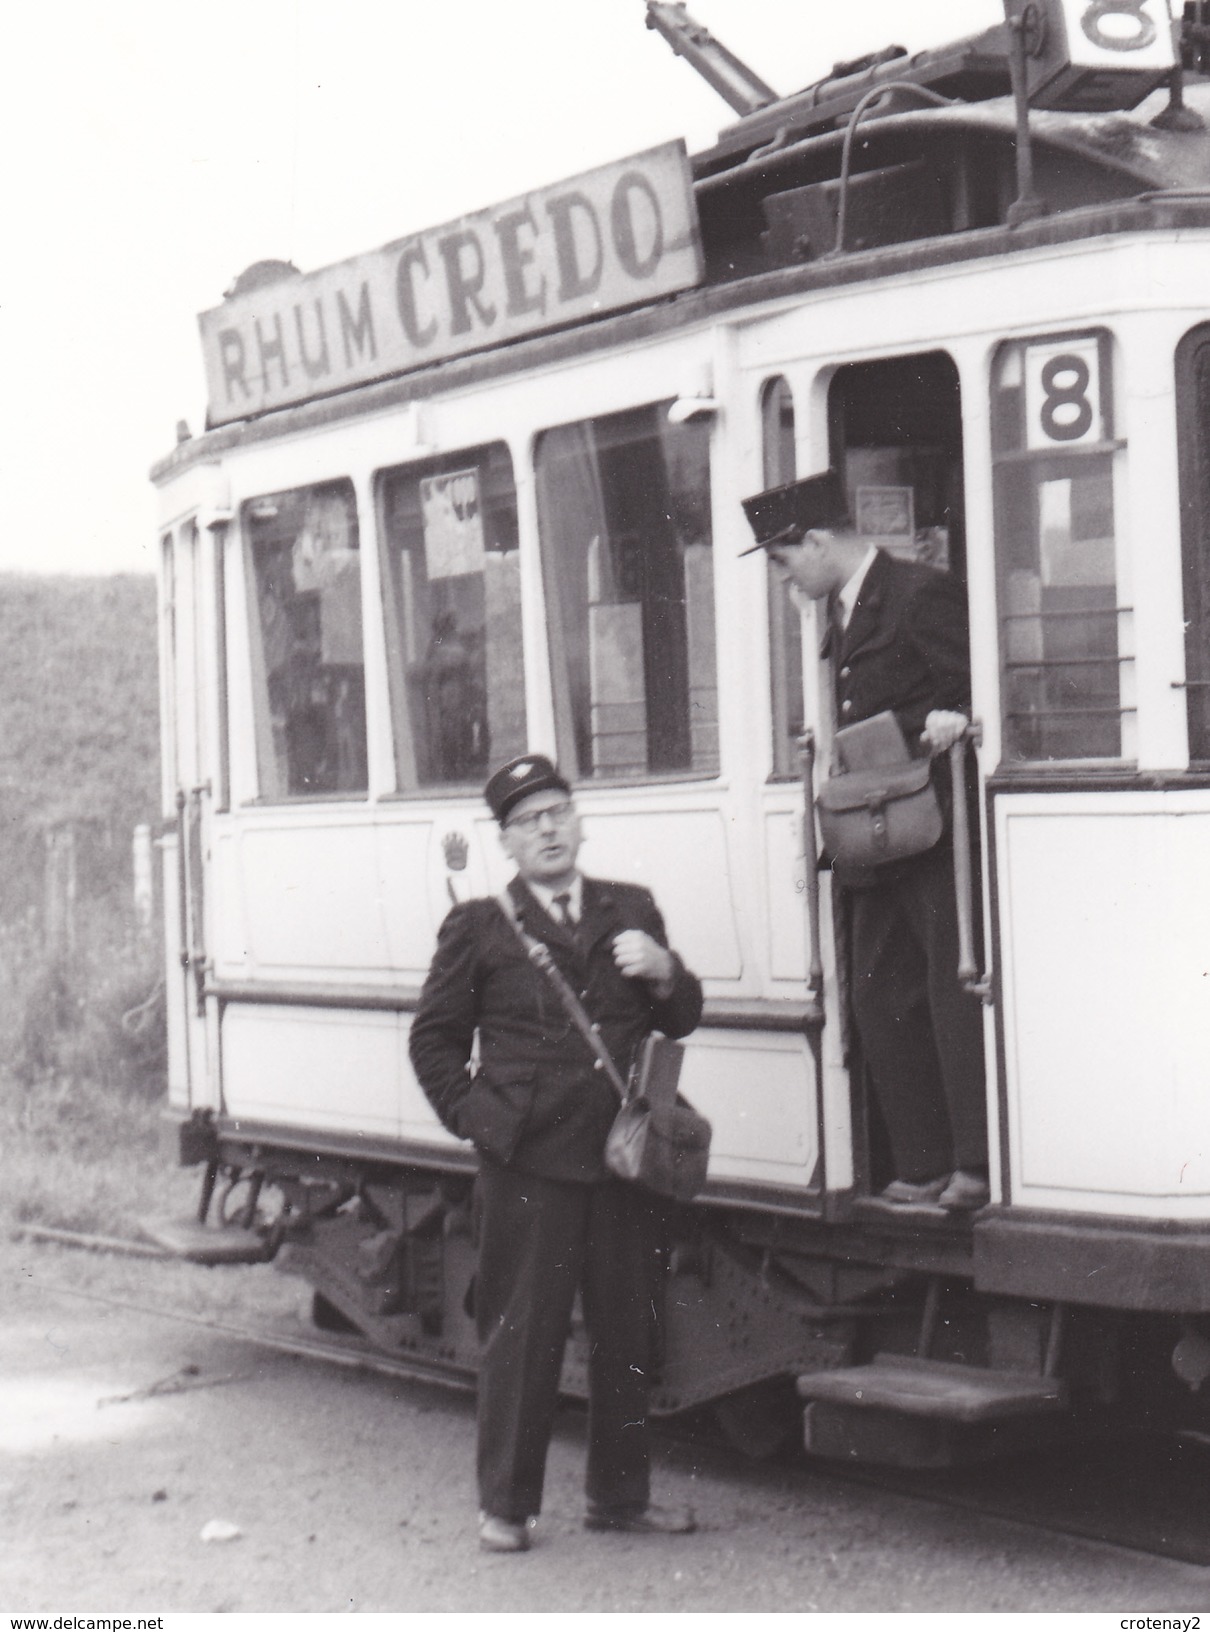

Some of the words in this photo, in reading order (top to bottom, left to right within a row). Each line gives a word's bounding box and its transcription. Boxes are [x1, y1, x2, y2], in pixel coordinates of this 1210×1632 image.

[218, 282, 377, 401] RHUM
[396, 170, 663, 348] CREDO
[1041, 354, 1092, 441] 8
